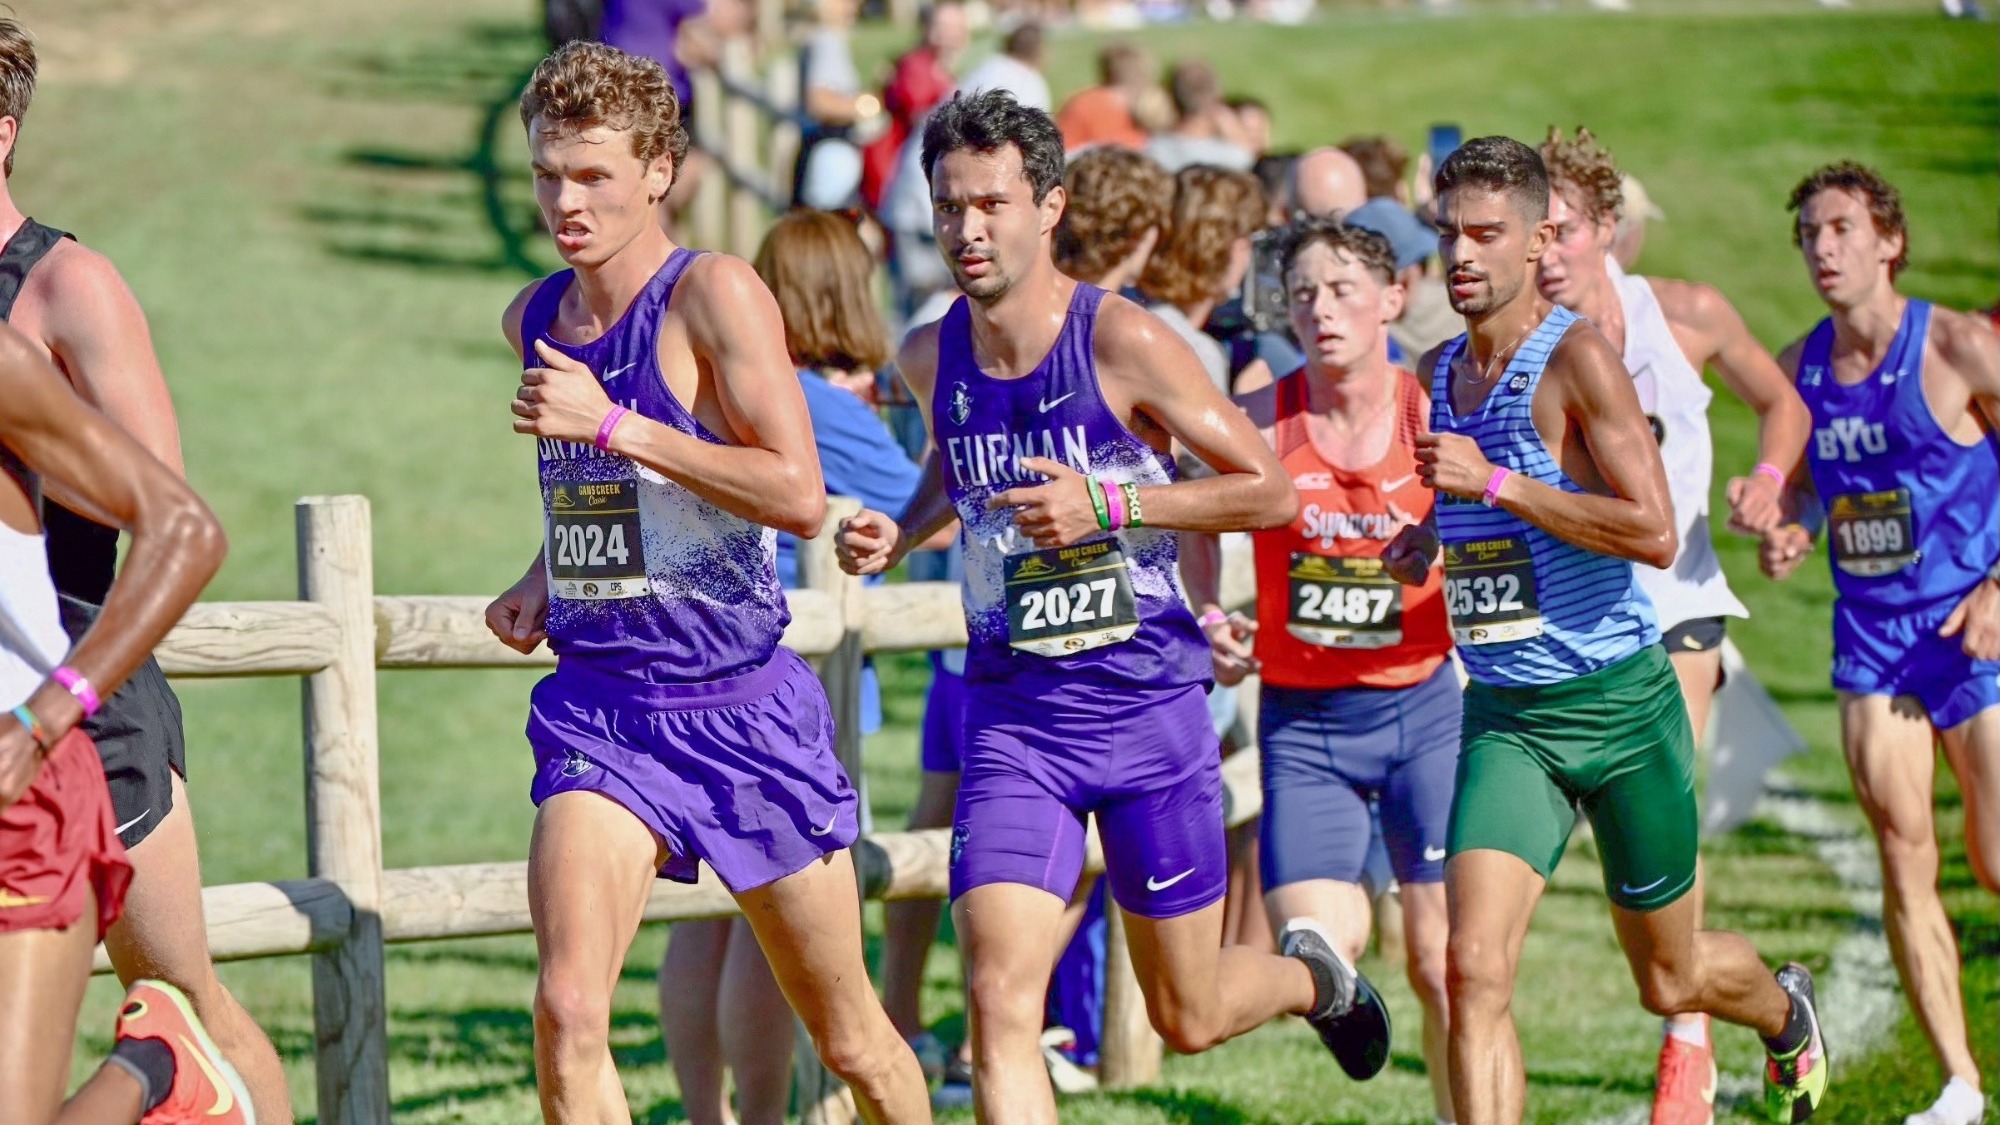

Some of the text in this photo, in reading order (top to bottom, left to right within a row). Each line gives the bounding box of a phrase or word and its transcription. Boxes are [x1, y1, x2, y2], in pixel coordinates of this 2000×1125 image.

[947, 425, 1091, 487] FURMAN
[1815, 416, 1888, 462] BYU
[579, 484, 620, 495] GANS CREEK
[554, 524, 629, 567] 2024
[1302, 503, 1391, 549] Syracu
[1465, 539, 1513, 553] GANS CREEK
[1838, 517, 1903, 554] 1899
[1059, 542, 1109, 560] GANS CREEK
[610, 582, 623, 591] CPS
[1020, 577, 1117, 630] 2027
[1298, 584, 1394, 624] 2487
[1445, 574, 1524, 616] 2532
